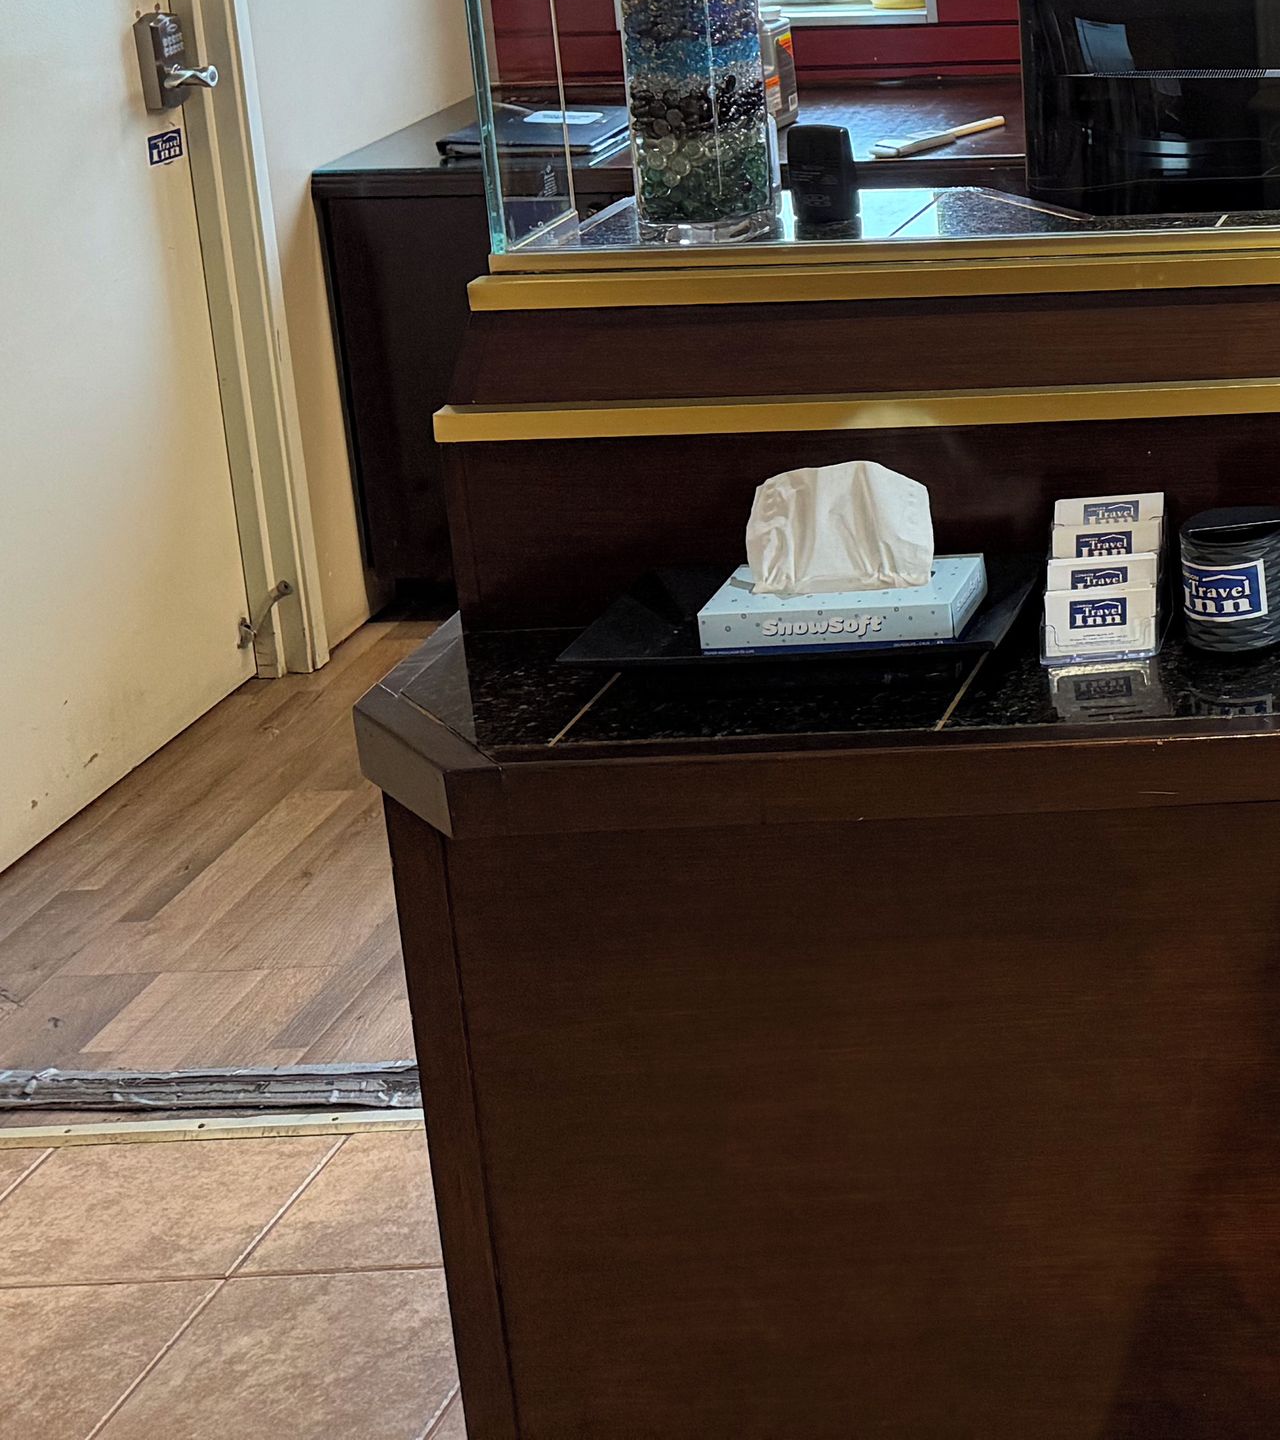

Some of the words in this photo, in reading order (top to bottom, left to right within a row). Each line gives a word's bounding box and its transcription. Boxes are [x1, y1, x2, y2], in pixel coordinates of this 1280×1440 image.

[152, 146, 180, 163] Inn
[1096, 505, 1134, 518] Travel
[1089, 536, 1127, 549] Travel
[1085, 572, 1123, 585] Travel
[1188, 579, 1251, 598] Travel
[1184, 585, 1253, 613] Inn
[1083, 603, 1121, 616] Travel
[762, 615, 883, 637] SnowSoft
[1074, 612, 1122, 627] Inn
